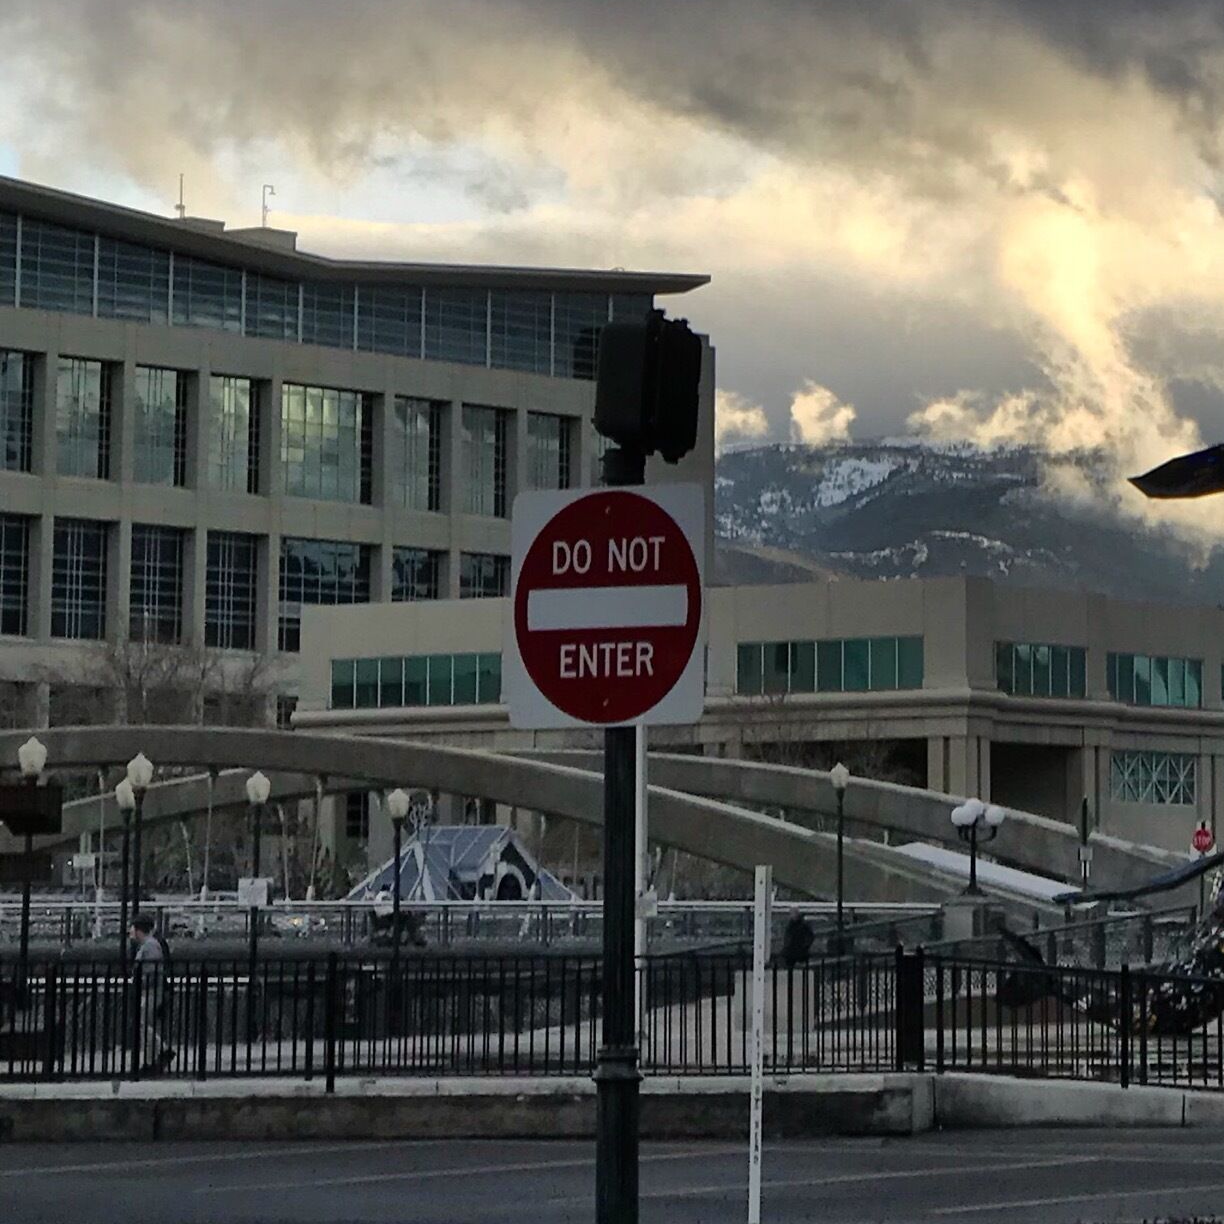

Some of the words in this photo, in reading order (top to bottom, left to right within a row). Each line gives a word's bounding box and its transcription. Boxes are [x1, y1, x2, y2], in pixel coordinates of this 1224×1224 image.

[552, 539, 592, 575] DO
[607, 536, 665, 573] NOT
[559, 642, 654, 678] ENTER
[1193, 835, 1211, 847] STOP
